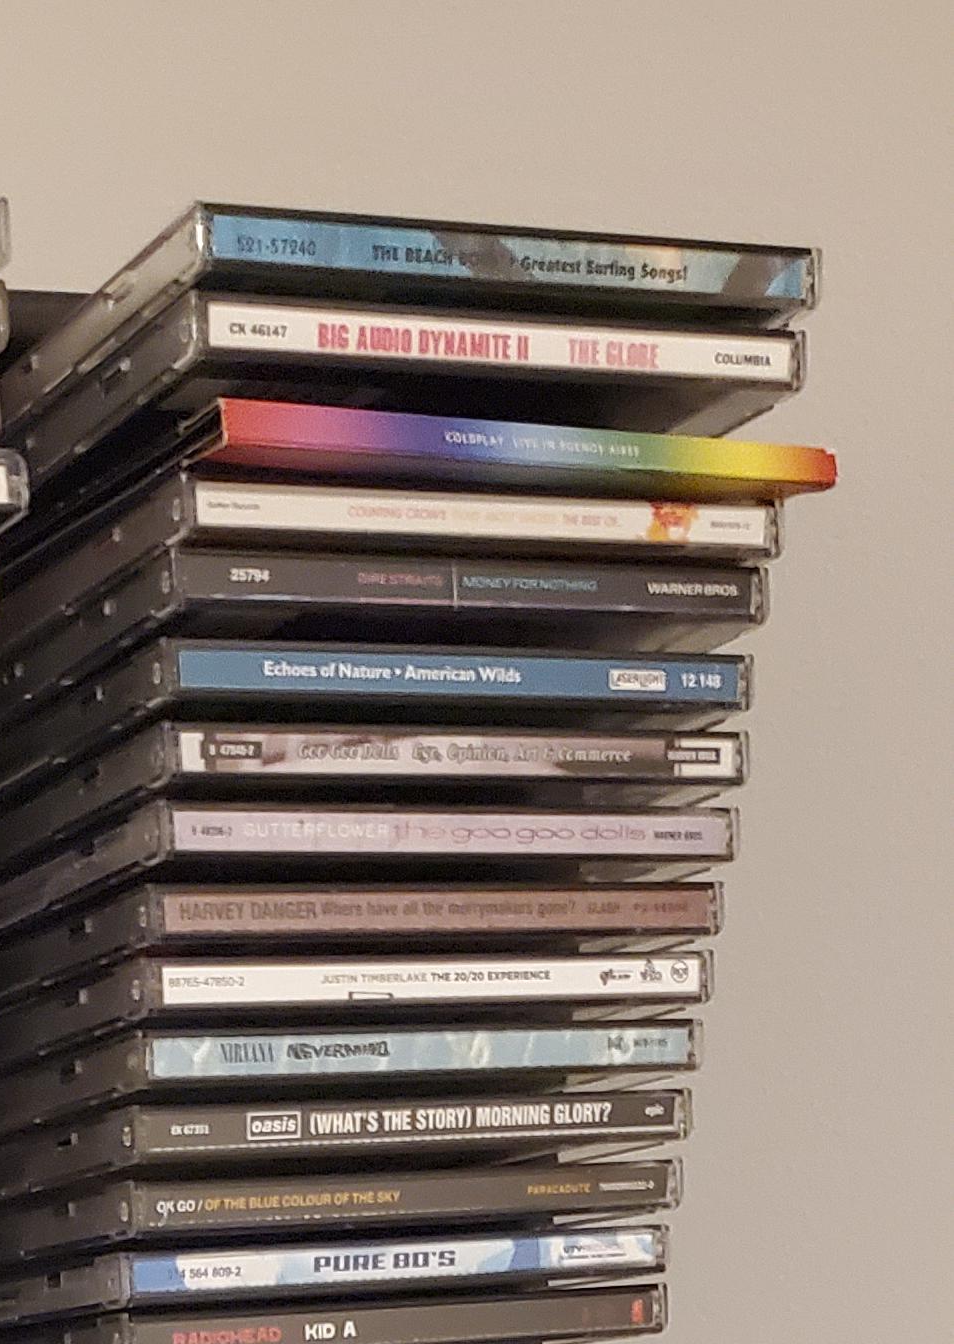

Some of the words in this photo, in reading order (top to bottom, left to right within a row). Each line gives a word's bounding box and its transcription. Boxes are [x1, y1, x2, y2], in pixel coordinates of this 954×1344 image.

[520, 254, 581, 274] Greatest
[586, 258, 635, 281] Surfing
[640, 263, 688, 284] Songs!
[317, 322, 349, 349] BIG
[356, 325, 412, 355] AUDIO
[419, 329, 511, 361] DYNAMITE
[517, 335, 530, 362] II
[568, 337, 599, 367] THE
[606, 340, 660, 370] GLOBE
[714, 351, 772, 367] COLUMBIA
[262, 660, 316, 679] Echoes
[320, 660, 336, 679] of
[338, 662, 393, 681] Nature
[404, 664, 476, 683] American
[478, 667, 523, 685] Wilds
[320, 973, 357, 985] JUSTIN
[361, 972, 427, 985] TIMBERLAKE
[431, 971, 451, 983] THE
[454, 970, 484, 983] 20/20
[487, 968, 551, 982] EXPERIENCE
[251, 1116, 296, 1134] oasis
[309, 1111, 378, 1136] (WHAT'S
[382, 1110, 412, 1132] THE
[416, 1106, 472, 1131] STORY)
[476, 1103, 551, 1127] MORNING
[554, 1101, 613, 1125] GLORY?
[313, 1252, 387, 1273] PURE
[393, 1249, 456, 1269] 80'S
[304, 1322, 336, 1341] KID
[343, 1320, 357, 1338] A
